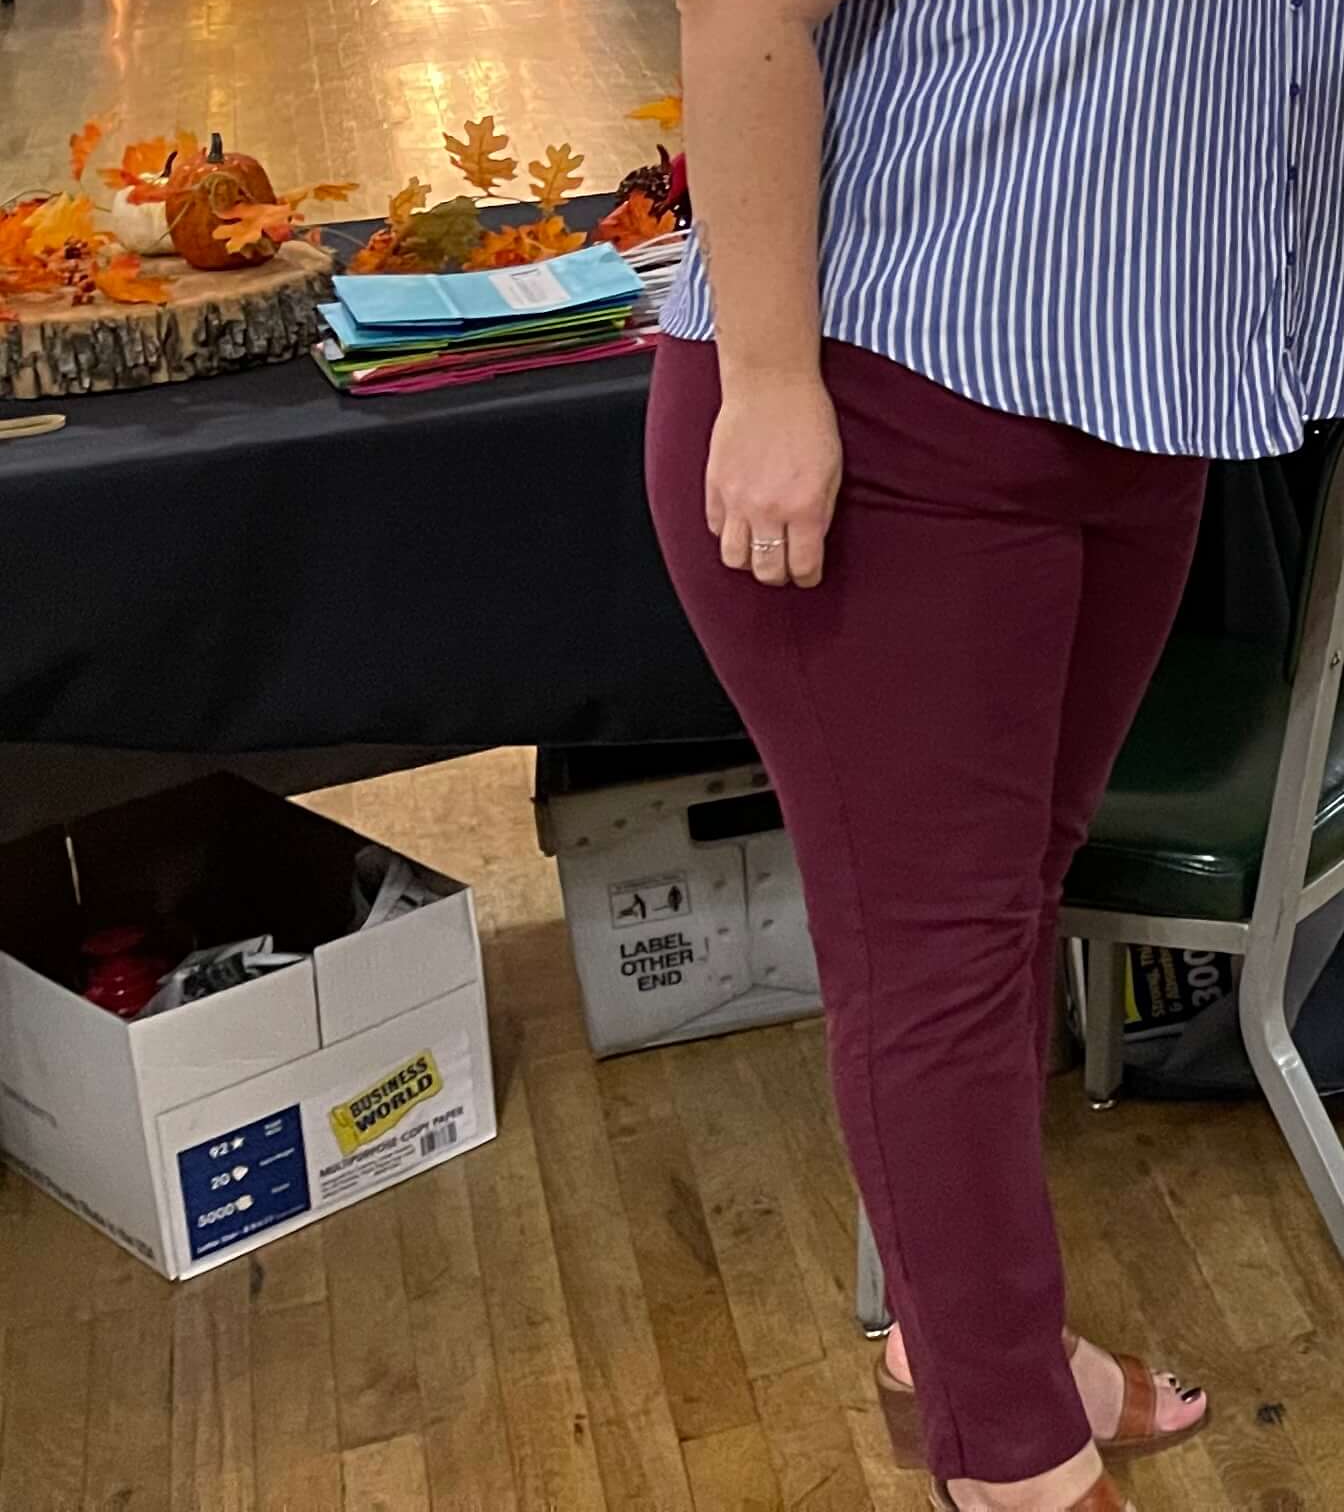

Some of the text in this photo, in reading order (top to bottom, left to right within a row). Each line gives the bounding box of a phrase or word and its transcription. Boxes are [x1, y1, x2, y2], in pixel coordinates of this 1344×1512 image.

[620, 931, 692, 960] LABEL
[621, 948, 694, 977] OTHER
[637, 970, 683, 992] END
[349, 1056, 429, 1119] BUSINESS
[355, 1073, 433, 1133] WORLD
[401, 1121, 430, 1143] COPY
[208, 1141, 229, 1160] 92
[209, 1171, 231, 1190] 20
